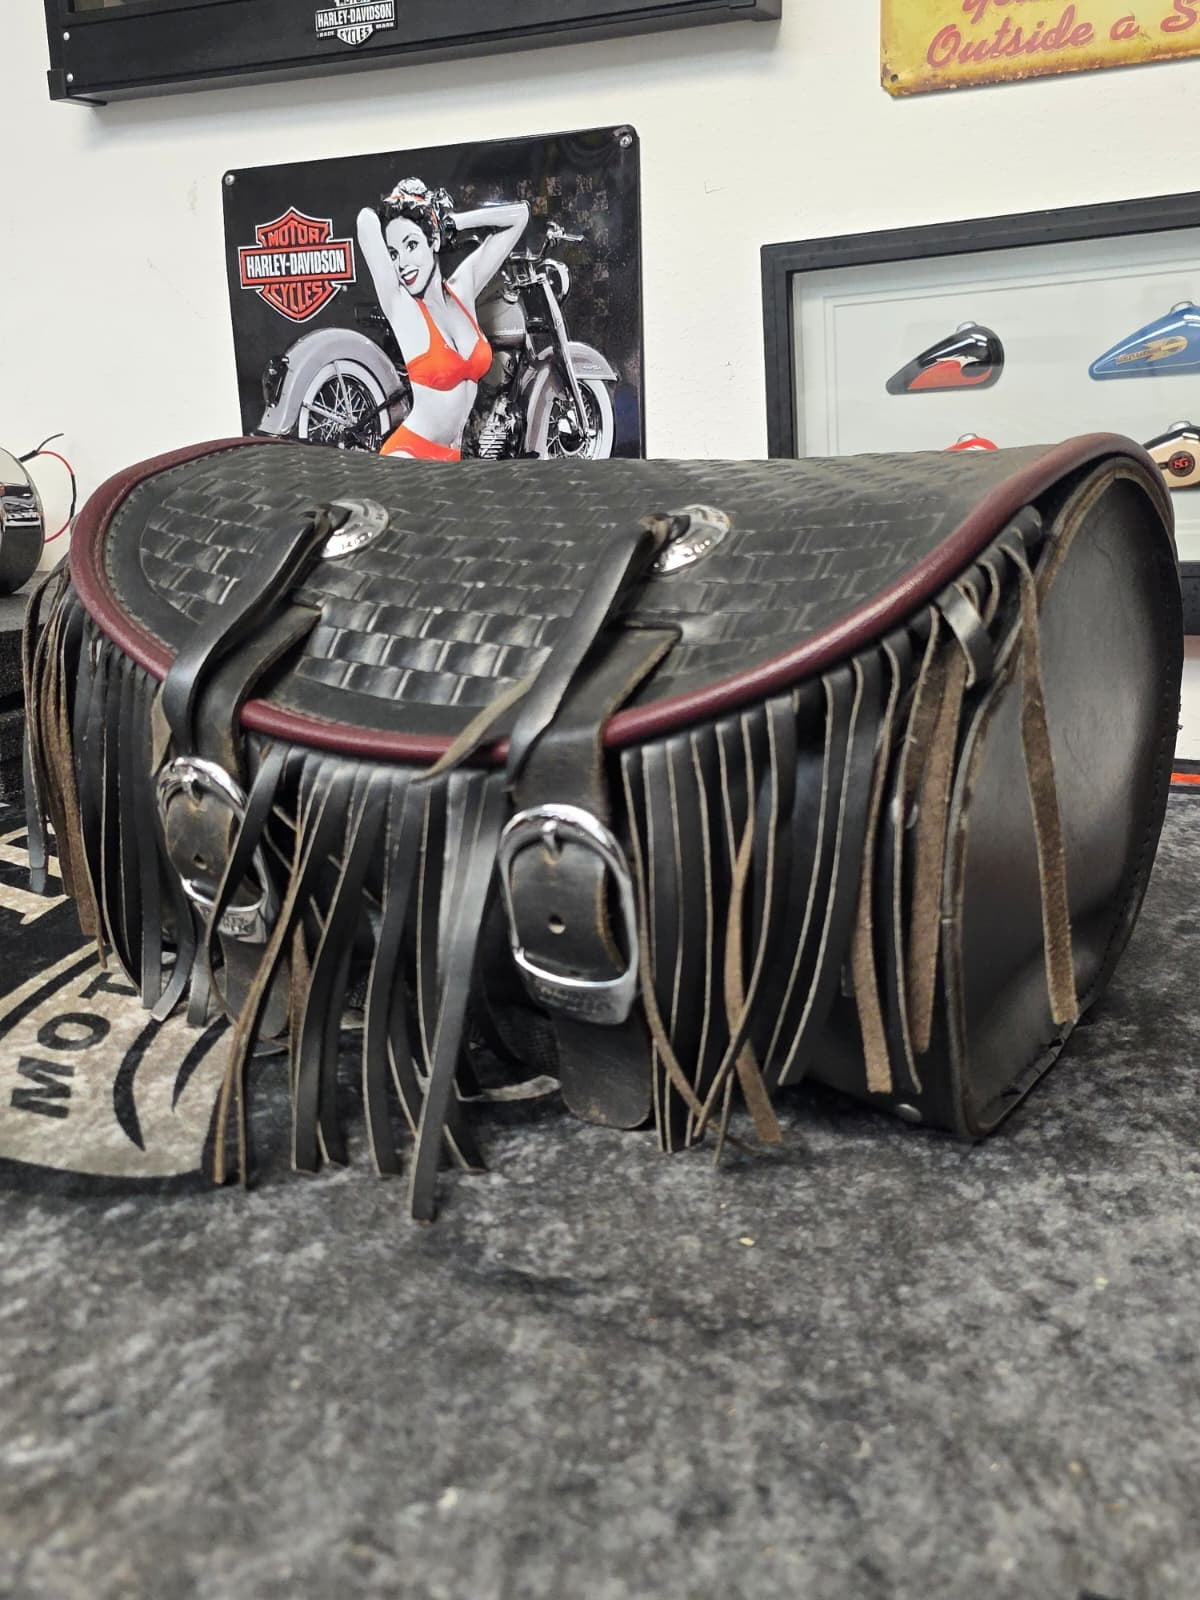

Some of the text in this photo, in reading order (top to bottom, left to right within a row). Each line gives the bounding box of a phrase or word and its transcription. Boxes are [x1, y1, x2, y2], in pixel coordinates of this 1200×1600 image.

[318, 3, 392, 28] HARLEY-DAVIDSON
[340, 26, 370, 43] CYCLES
[927, 4, 1094, 68] Outside
[1110, 15, 1140, 41] a
[268, 221, 320, 247] MOTOR
[246, 249, 346, 278] HARLEY-DAVIDSON
[271, 281, 323, 313] CYCLES
